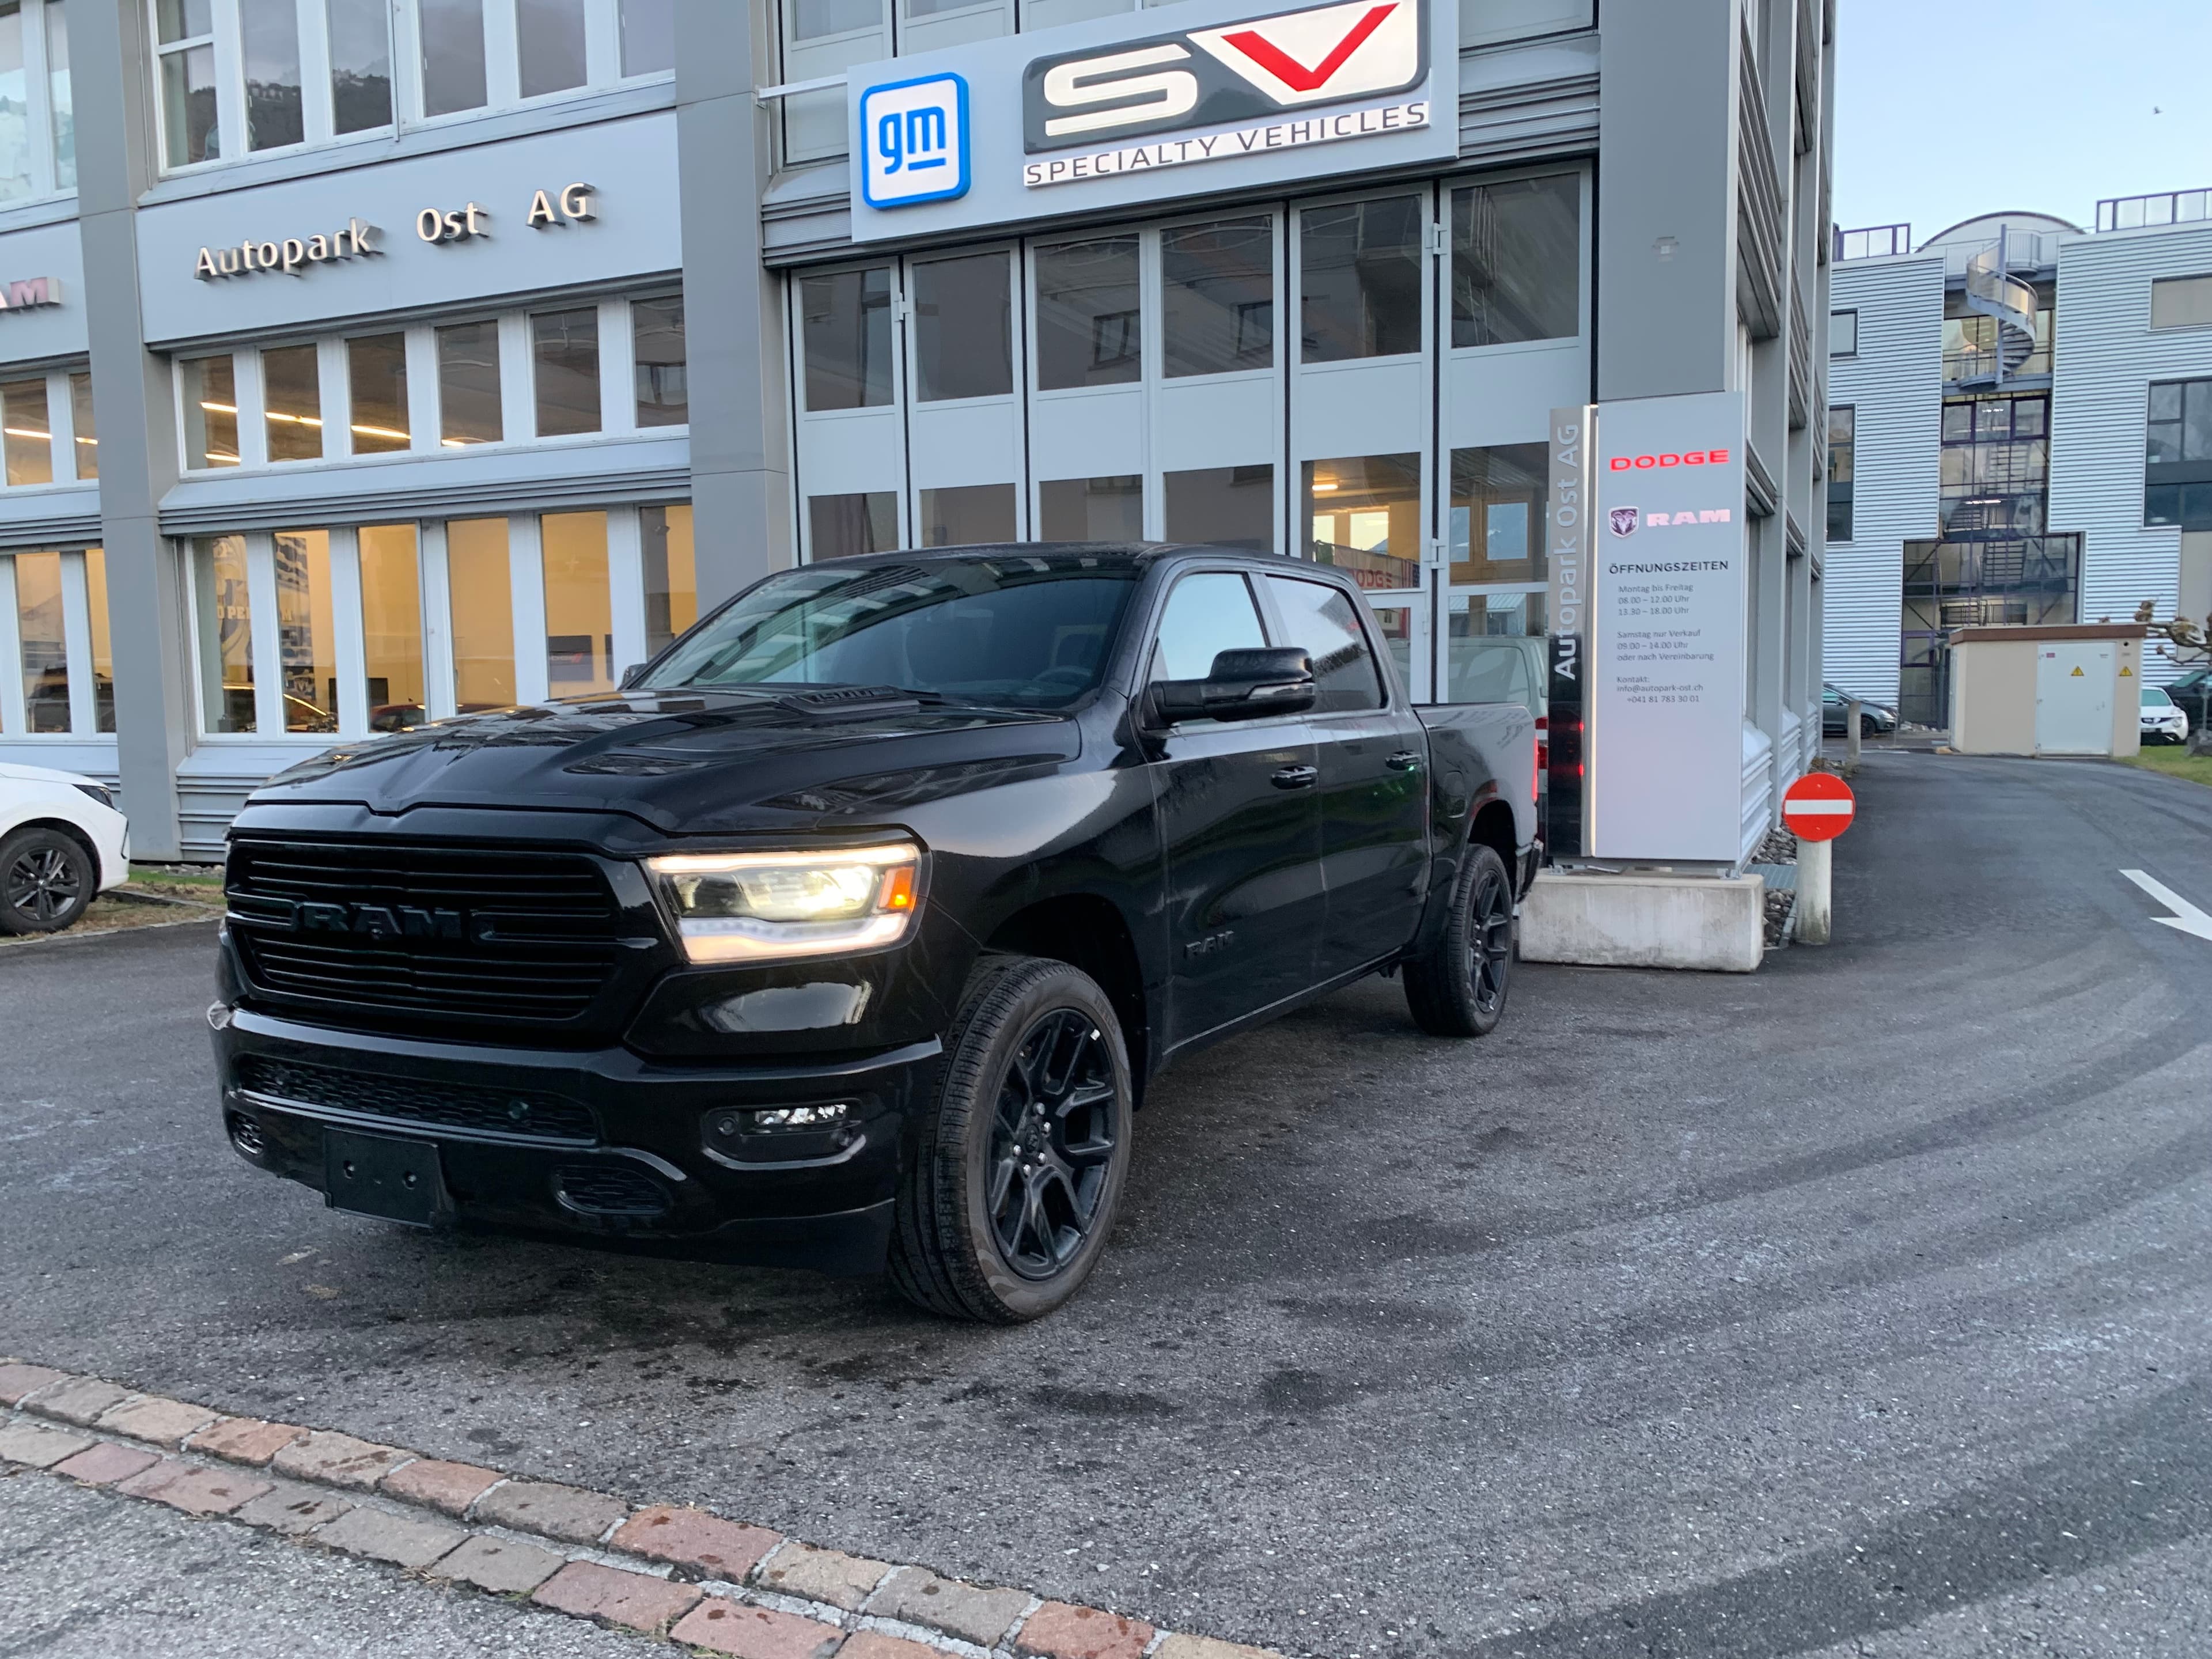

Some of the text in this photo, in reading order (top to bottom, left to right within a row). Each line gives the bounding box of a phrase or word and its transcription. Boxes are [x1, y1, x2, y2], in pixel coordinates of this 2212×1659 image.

[879, 106, 946, 175] gm
[1026, 103, 1426, 185] SPECIALTY VEHICLES
[195, 181, 592, 278] Autopark Ost AG
[1609, 449, 1730, 472] DODGE
[1646, 509, 1730, 527] RAM
[1554, 424, 1582, 680] Autopark Ost AG
[1609, 560, 1728, 574] ÖFFNUNGSZEITEN
[1618, 585, 1650, 593] Montag
[1665, 584, 1694, 592] Freitag
[1618, 631, 1652, 639] Samstag
[1668, 629, 1700, 637] Verkauf
[1659, 653, 1714, 661] Vereinbarung
[1616, 684, 1703, 693] info@autopark-ost.ch
[303, 902, 461, 940] RAM
[1184, 930, 1234, 959] RAM
